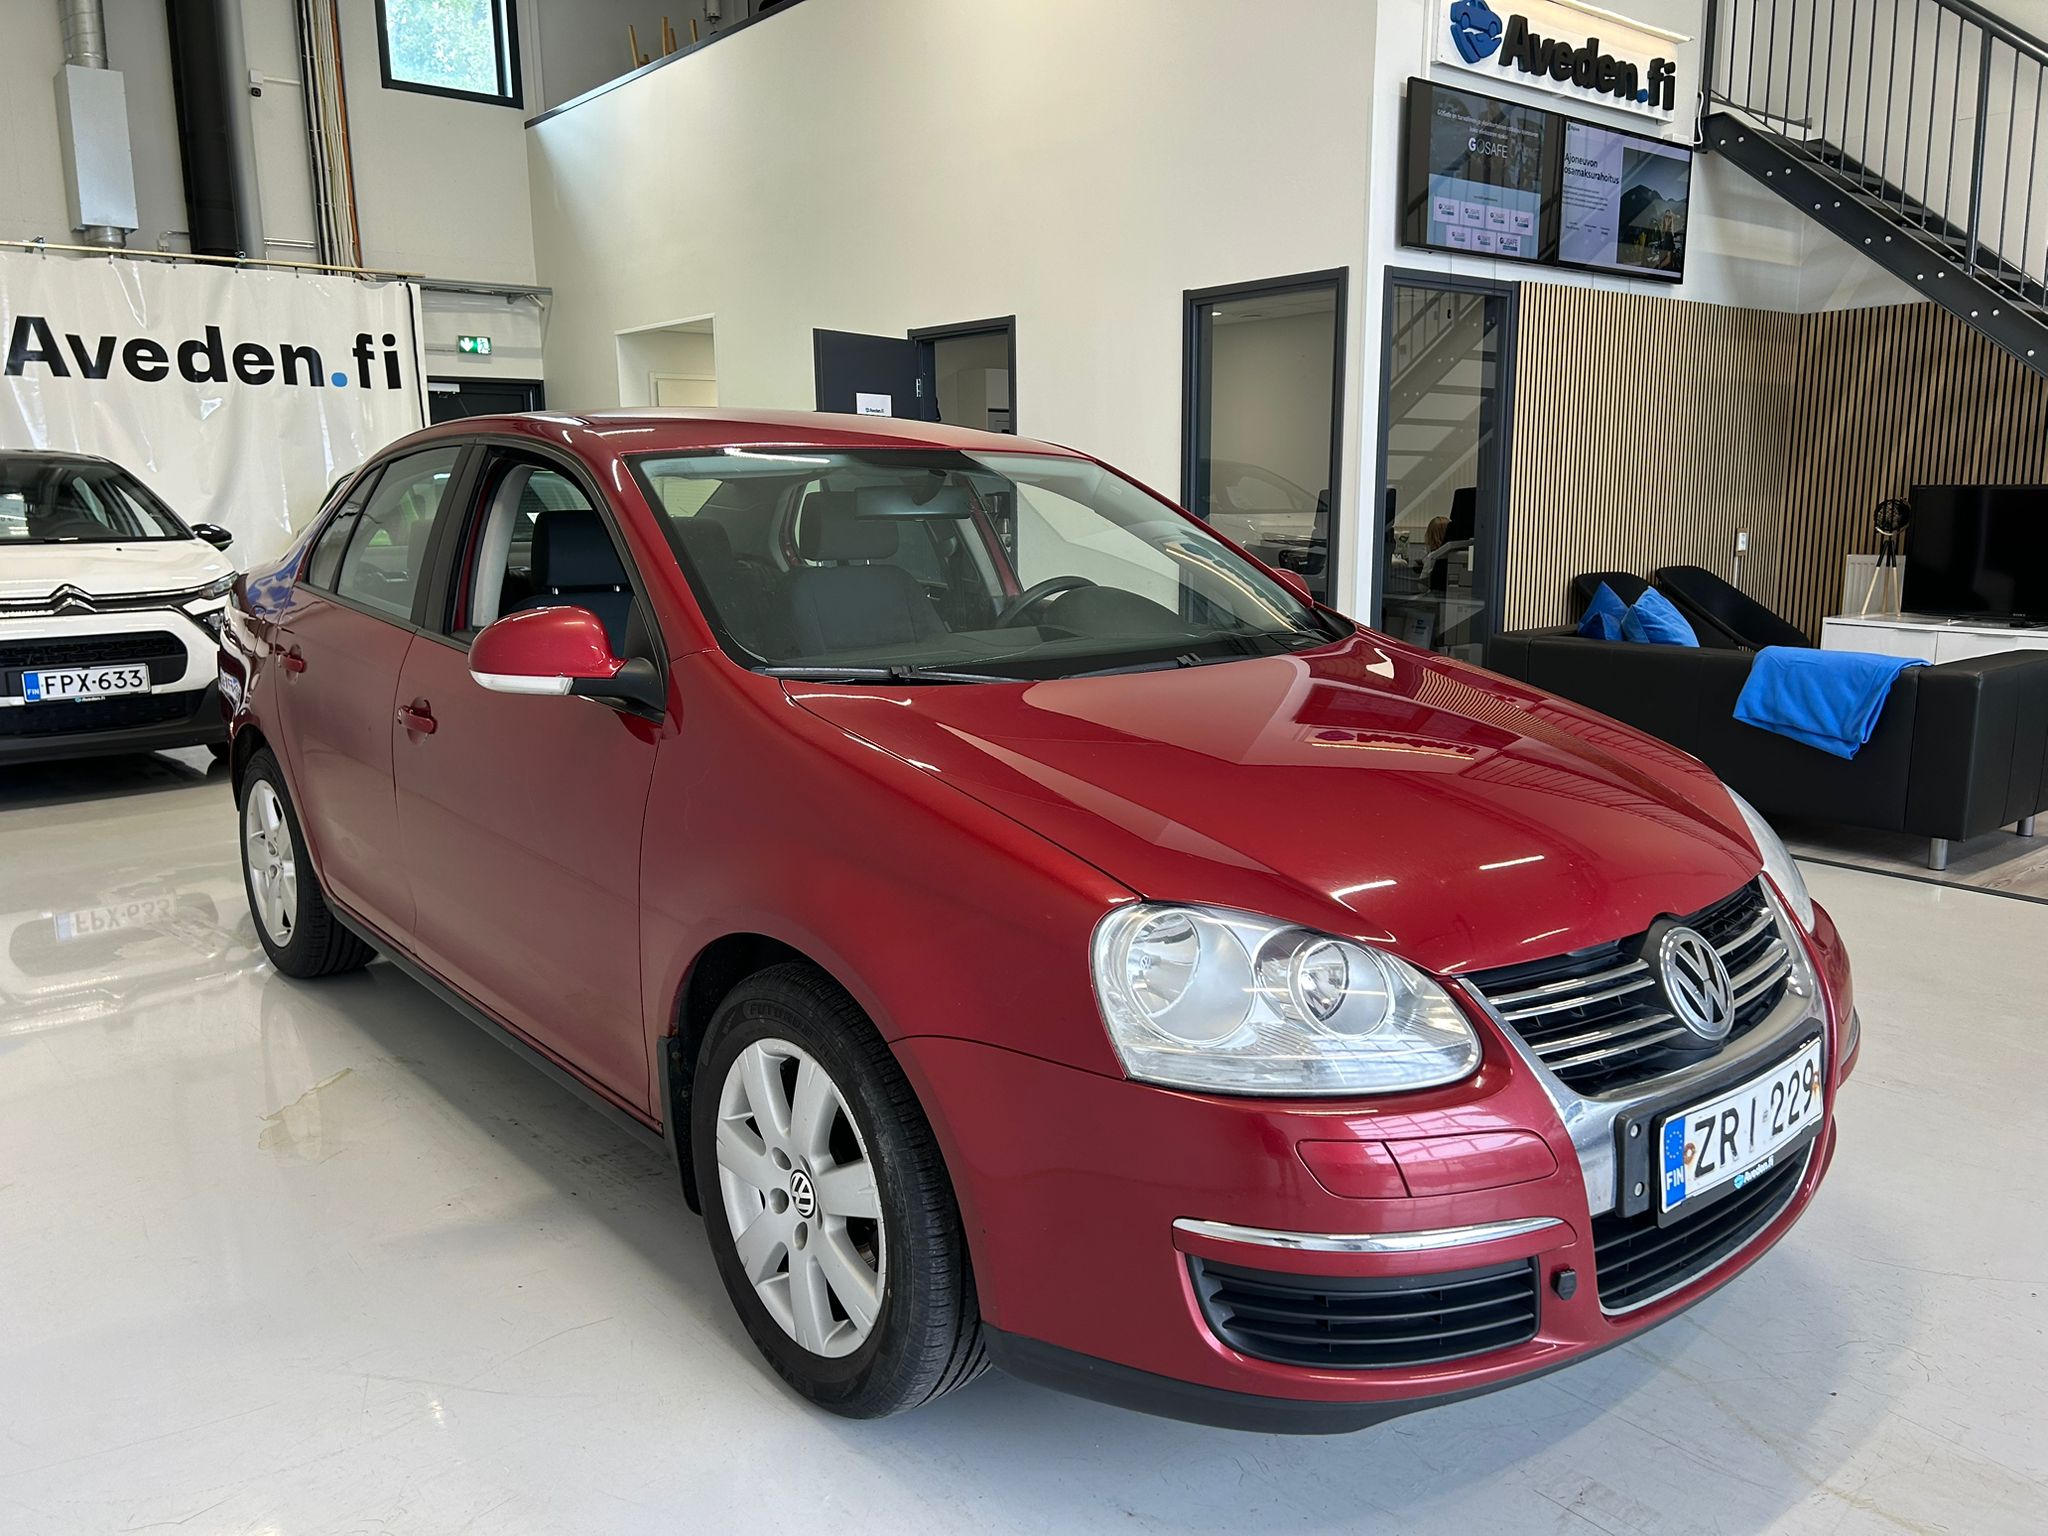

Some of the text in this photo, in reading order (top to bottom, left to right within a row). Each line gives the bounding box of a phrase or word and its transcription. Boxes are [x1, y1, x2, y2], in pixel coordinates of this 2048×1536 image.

[1498, 14, 1676, 111] Aveden.fi
[1565, 152, 1598, 168] Ajoneuvon
[4, 315, 402, 390] Aveden.fi
[27, 669, 143, 696] FIN FPX-633
[1666, 1166, 1684, 1191] FIN
